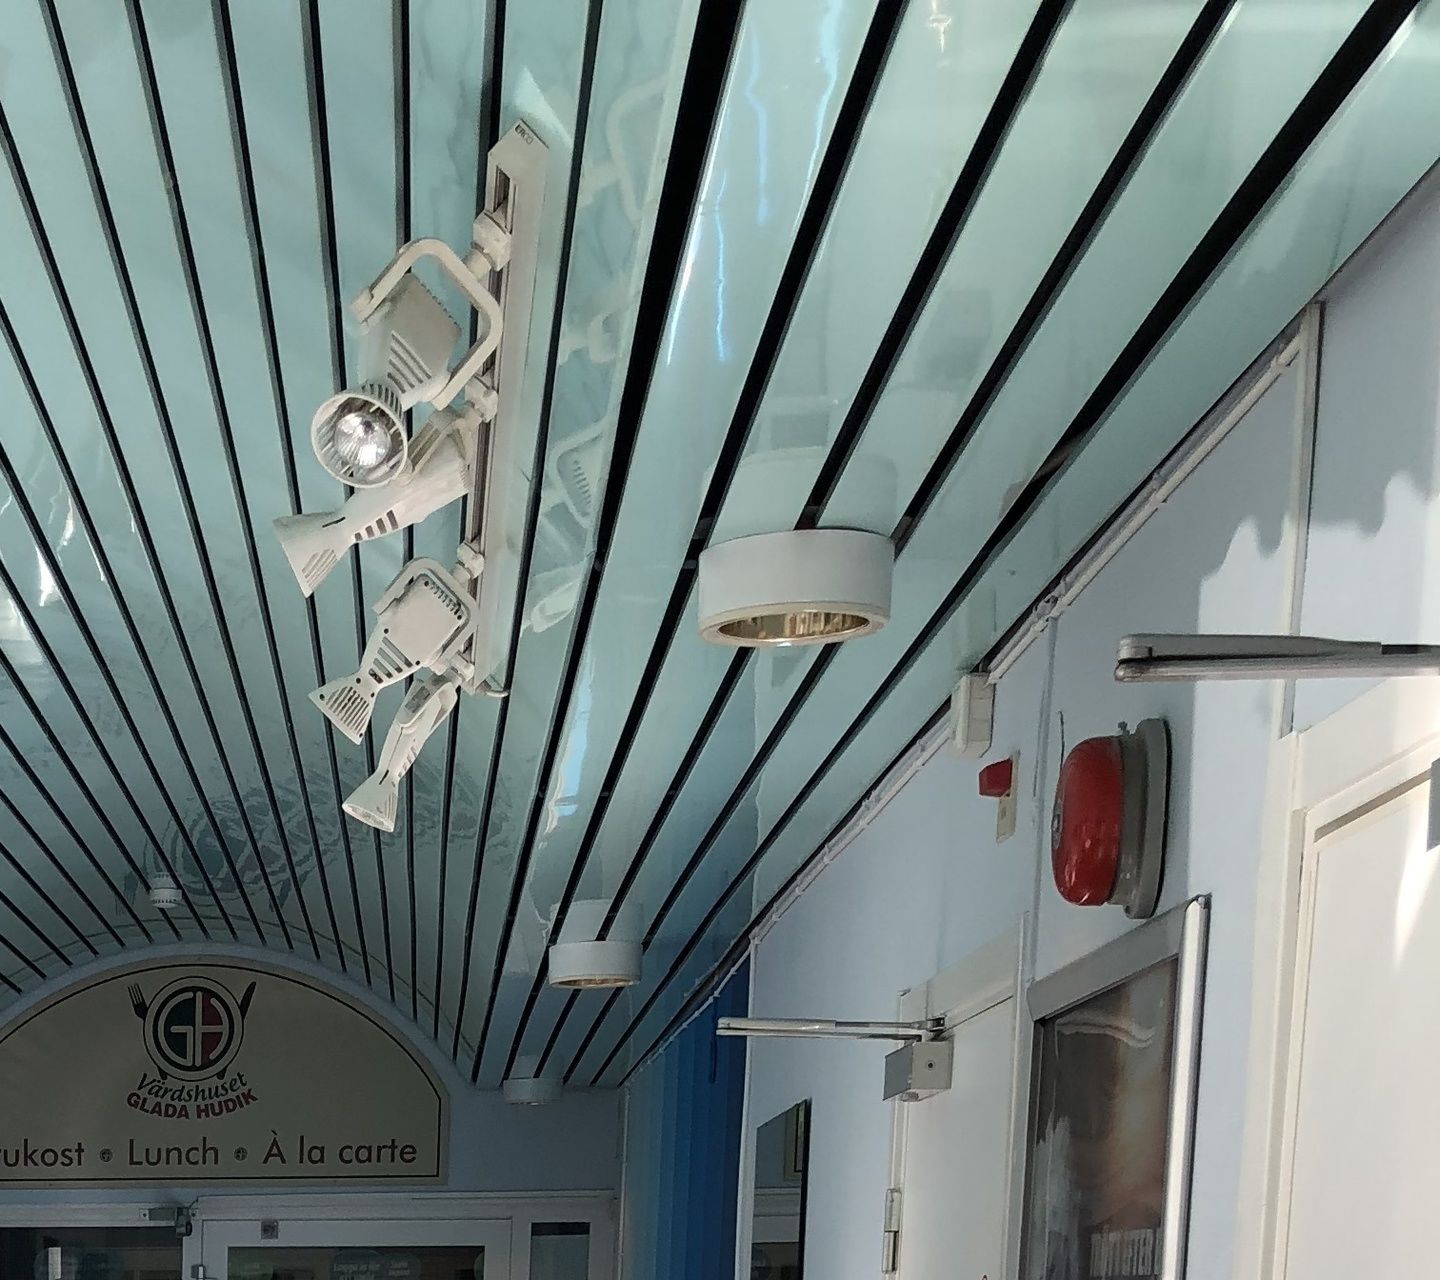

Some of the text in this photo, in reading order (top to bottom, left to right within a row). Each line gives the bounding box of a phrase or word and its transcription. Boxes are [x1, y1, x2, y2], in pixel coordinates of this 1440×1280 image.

[137, 1072, 246, 1102] Värdshuset
[127, 1088, 258, 1119] GLADA HUDIK
[127, 1136, 220, 1166] Lunch
[262, 1130, 287, 1164] À
[298, 1135, 326, 1164] la
[338, 1138, 418, 1164] carte
